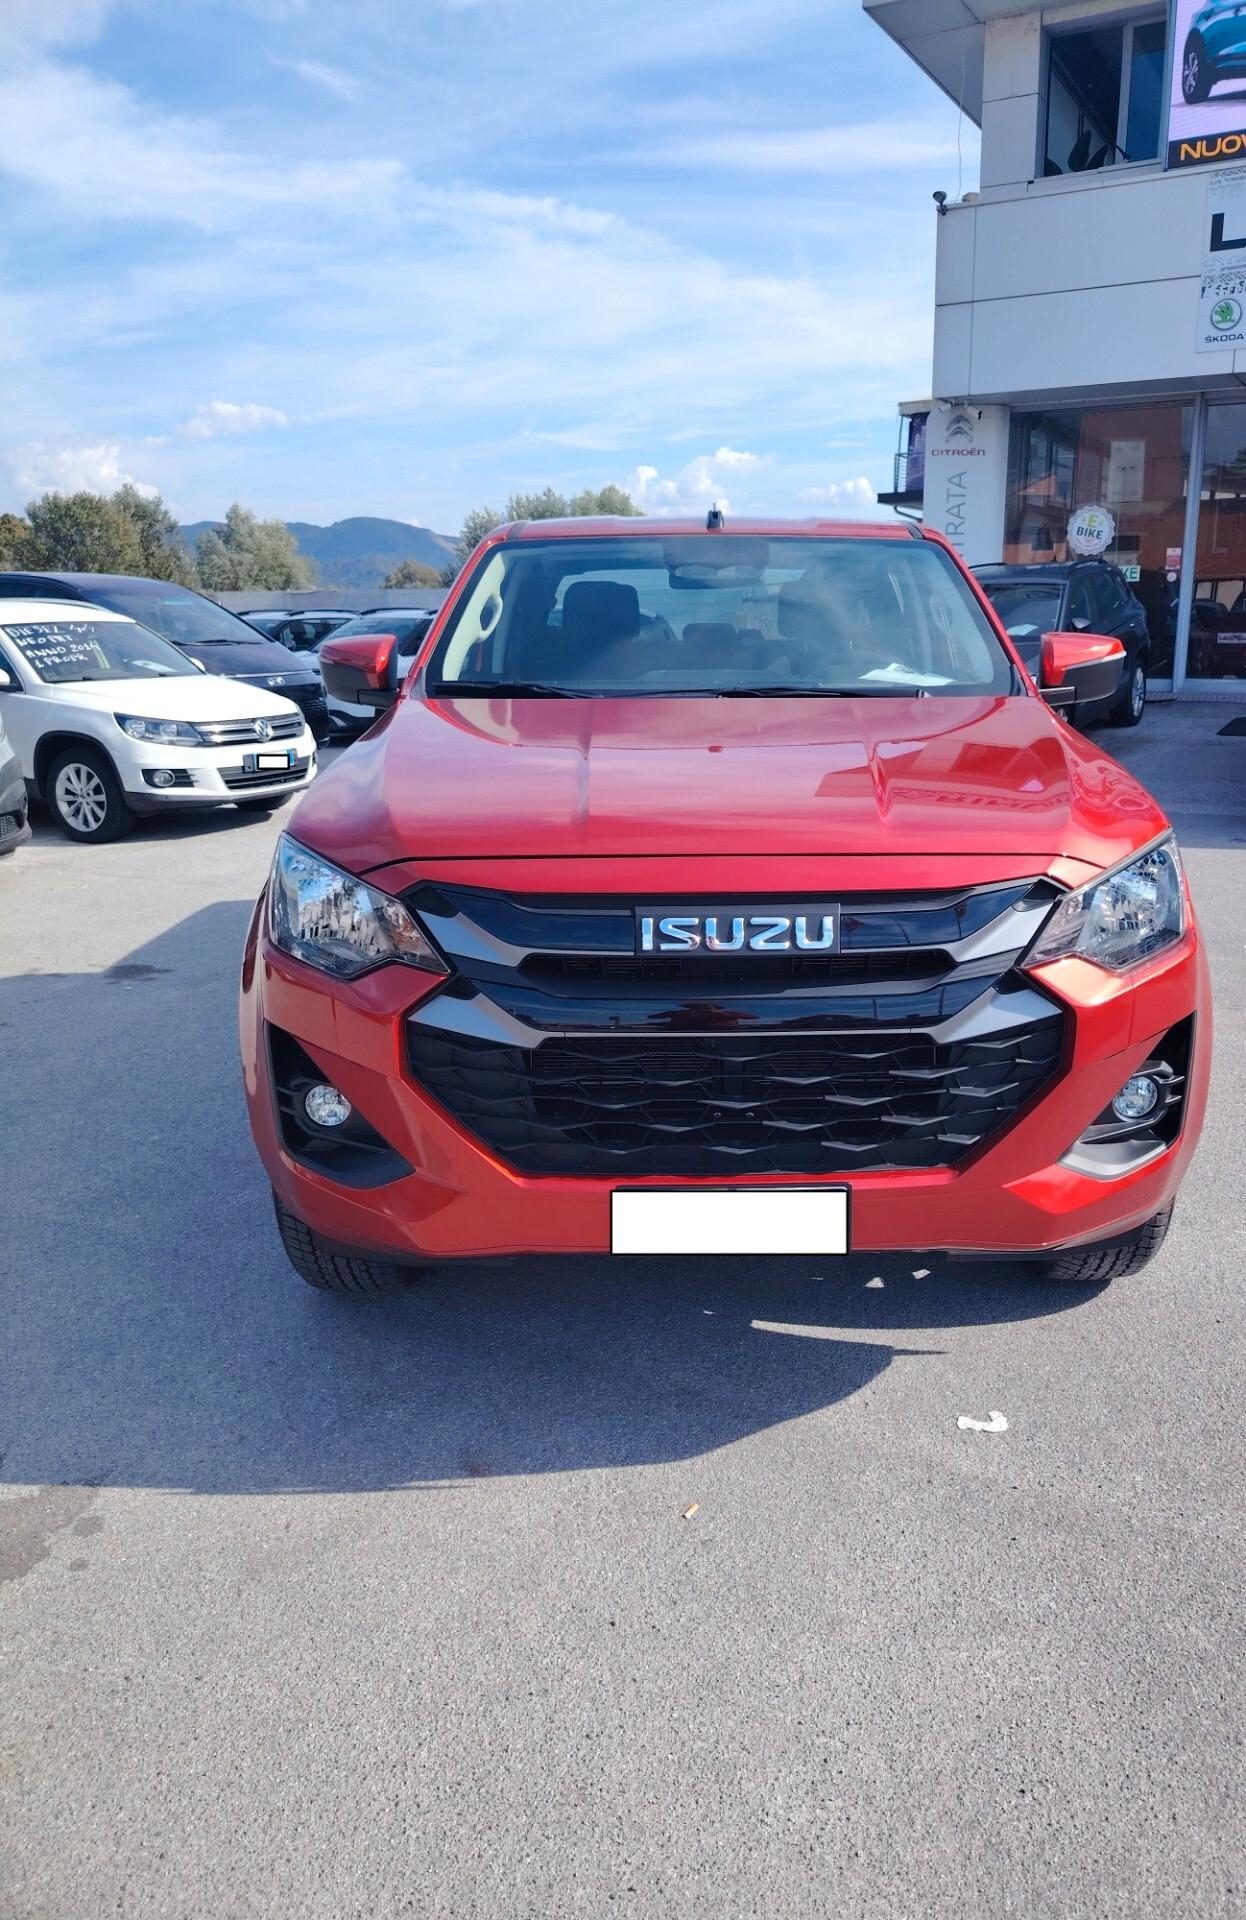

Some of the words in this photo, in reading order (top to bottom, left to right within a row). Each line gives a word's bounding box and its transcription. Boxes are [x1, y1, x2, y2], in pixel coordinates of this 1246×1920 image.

[1205, 333, 1244, 344] ŠKODA
[1076, 526, 1104, 539] BIKE
[641, 915, 834, 951] ISUZU
